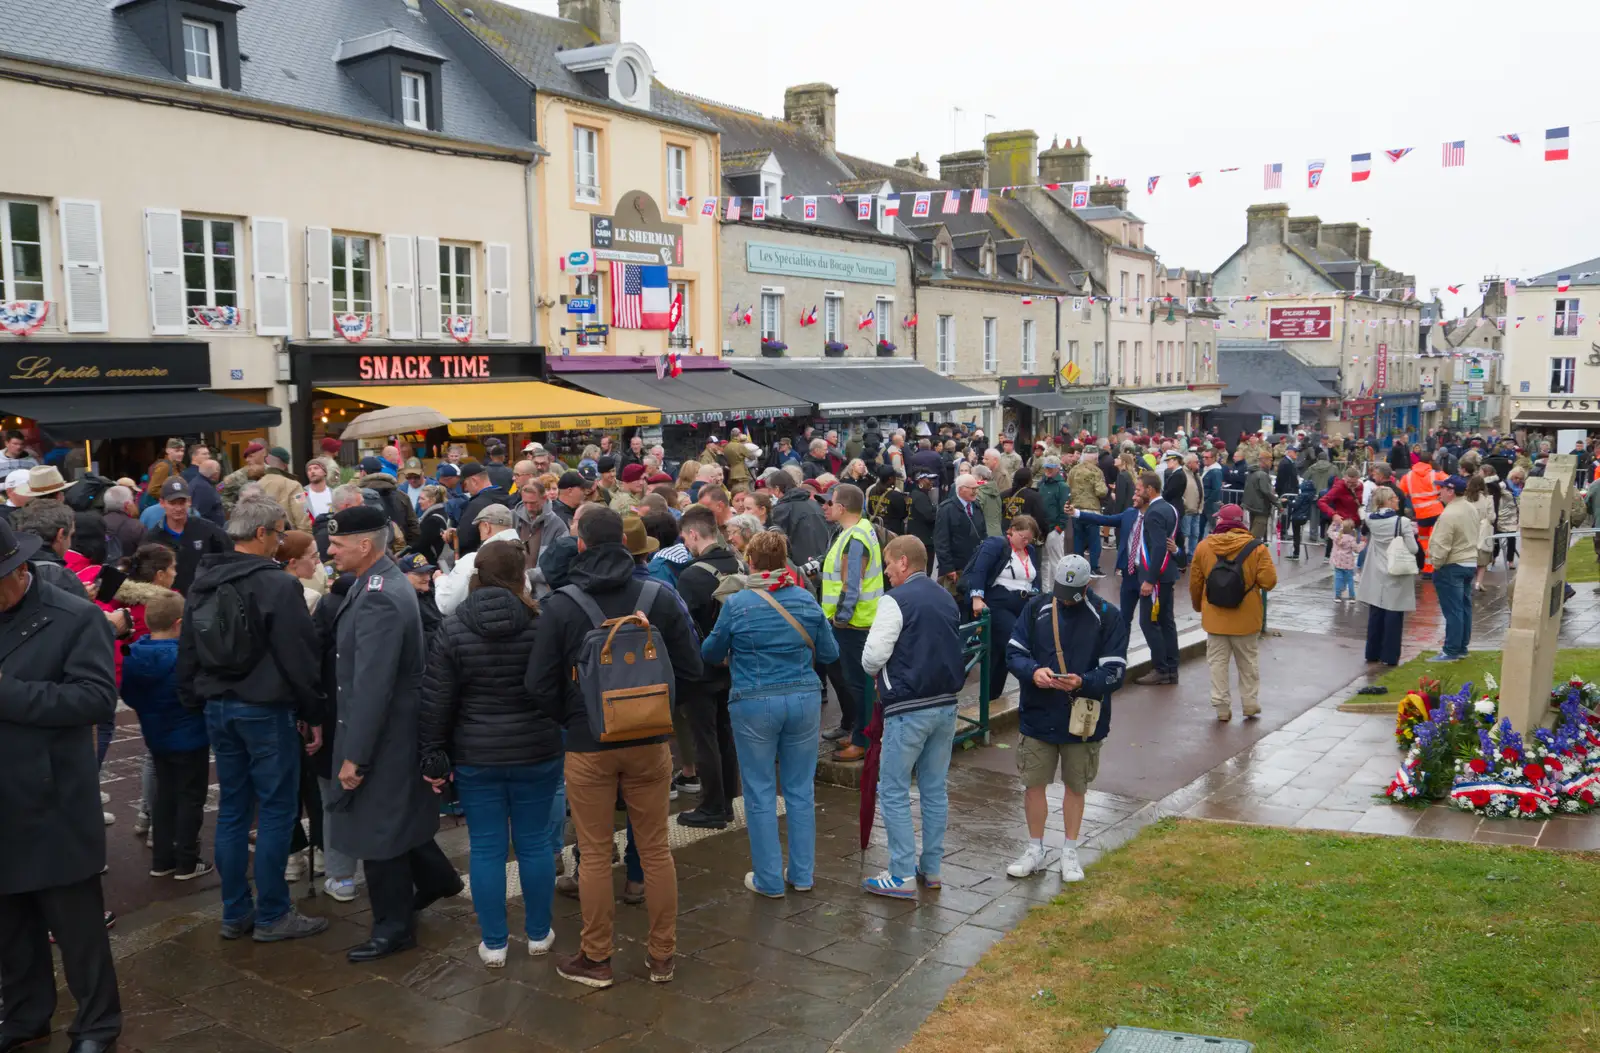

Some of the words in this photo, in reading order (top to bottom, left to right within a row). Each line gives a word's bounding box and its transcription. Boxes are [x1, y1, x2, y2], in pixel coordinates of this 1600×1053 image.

[615, 228, 627, 241] LE
[628, 229, 675, 247] SHERMAN
[759, 249, 773, 261] Les
[819, 256, 828, 268] du
[829, 258, 855, 277] Bocage
[856, 262, 888, 277] Normand
[570, 300, 584, 308] FDJ
[9, 356, 51, 379] La
[44, 364, 101, 385] petite
[105, 366, 169, 377] armoire
[359, 355, 433, 380] SNACK
[440, 355, 490, 378] TIME
[666, 413, 695, 424] TABAC
[702, 411, 723, 422] LOTO
[754, 407, 794, 419] SOUVENIRS
